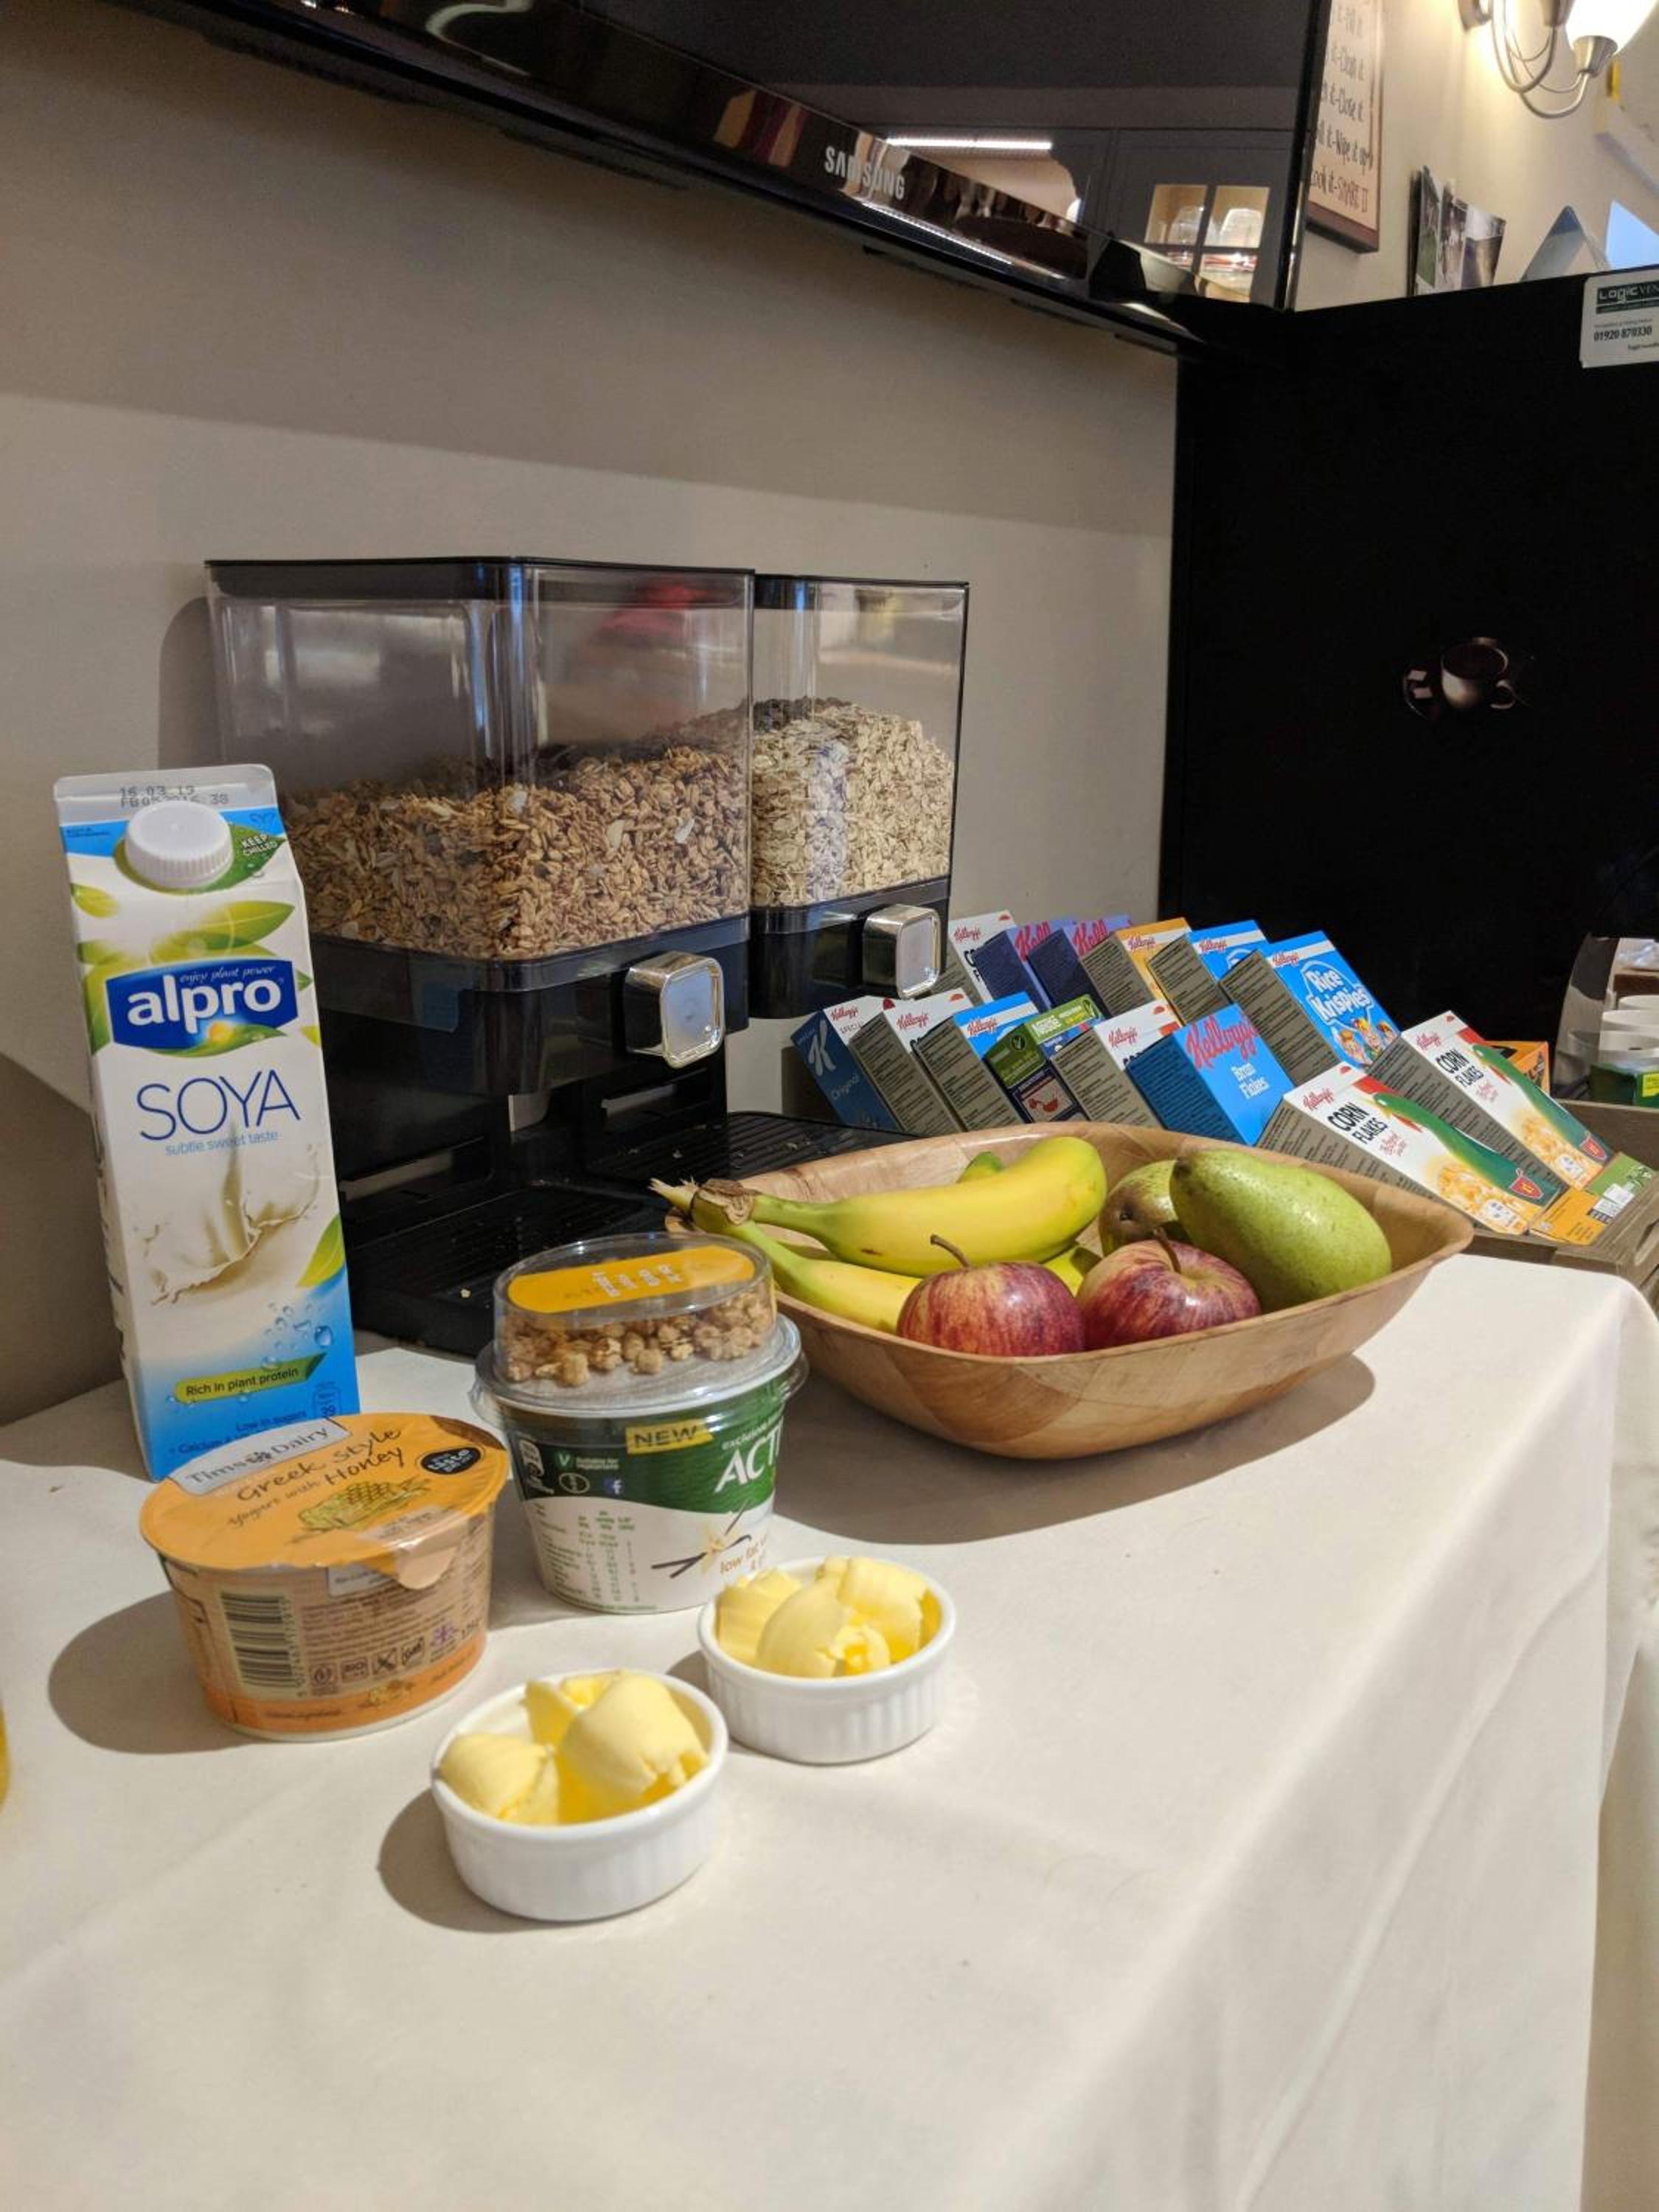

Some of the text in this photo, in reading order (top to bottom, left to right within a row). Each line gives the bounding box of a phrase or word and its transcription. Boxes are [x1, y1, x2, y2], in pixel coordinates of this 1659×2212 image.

[824, 145, 905, 201] SAMSUNG
[242, 833, 268, 849] KEEP
[180, 965, 276, 984] enjoy plant power
[1304, 970, 1344, 992] Rice
[128, 975, 282, 1034] alpro
[1310, 987, 1371, 1020] Krispies
[1436, 1048, 1470, 1074] CORN
[1455, 1065, 1484, 1088] FLAKES
[136, 1068, 301, 1141] SOYA
[1327, 1101, 1370, 1131] CORN
[165, 1132, 279, 1155] subtle sweet taste
[1352, 1117, 1388, 1144] FLAKES
[186, 1368, 299, 1397] Rich in plant protein
[271, 1427, 330, 1455] Dairy
[633, 1424, 698, 1448] NEW
[324, 1447, 404, 1485] Honey
[237, 1461, 324, 1501] Greek
